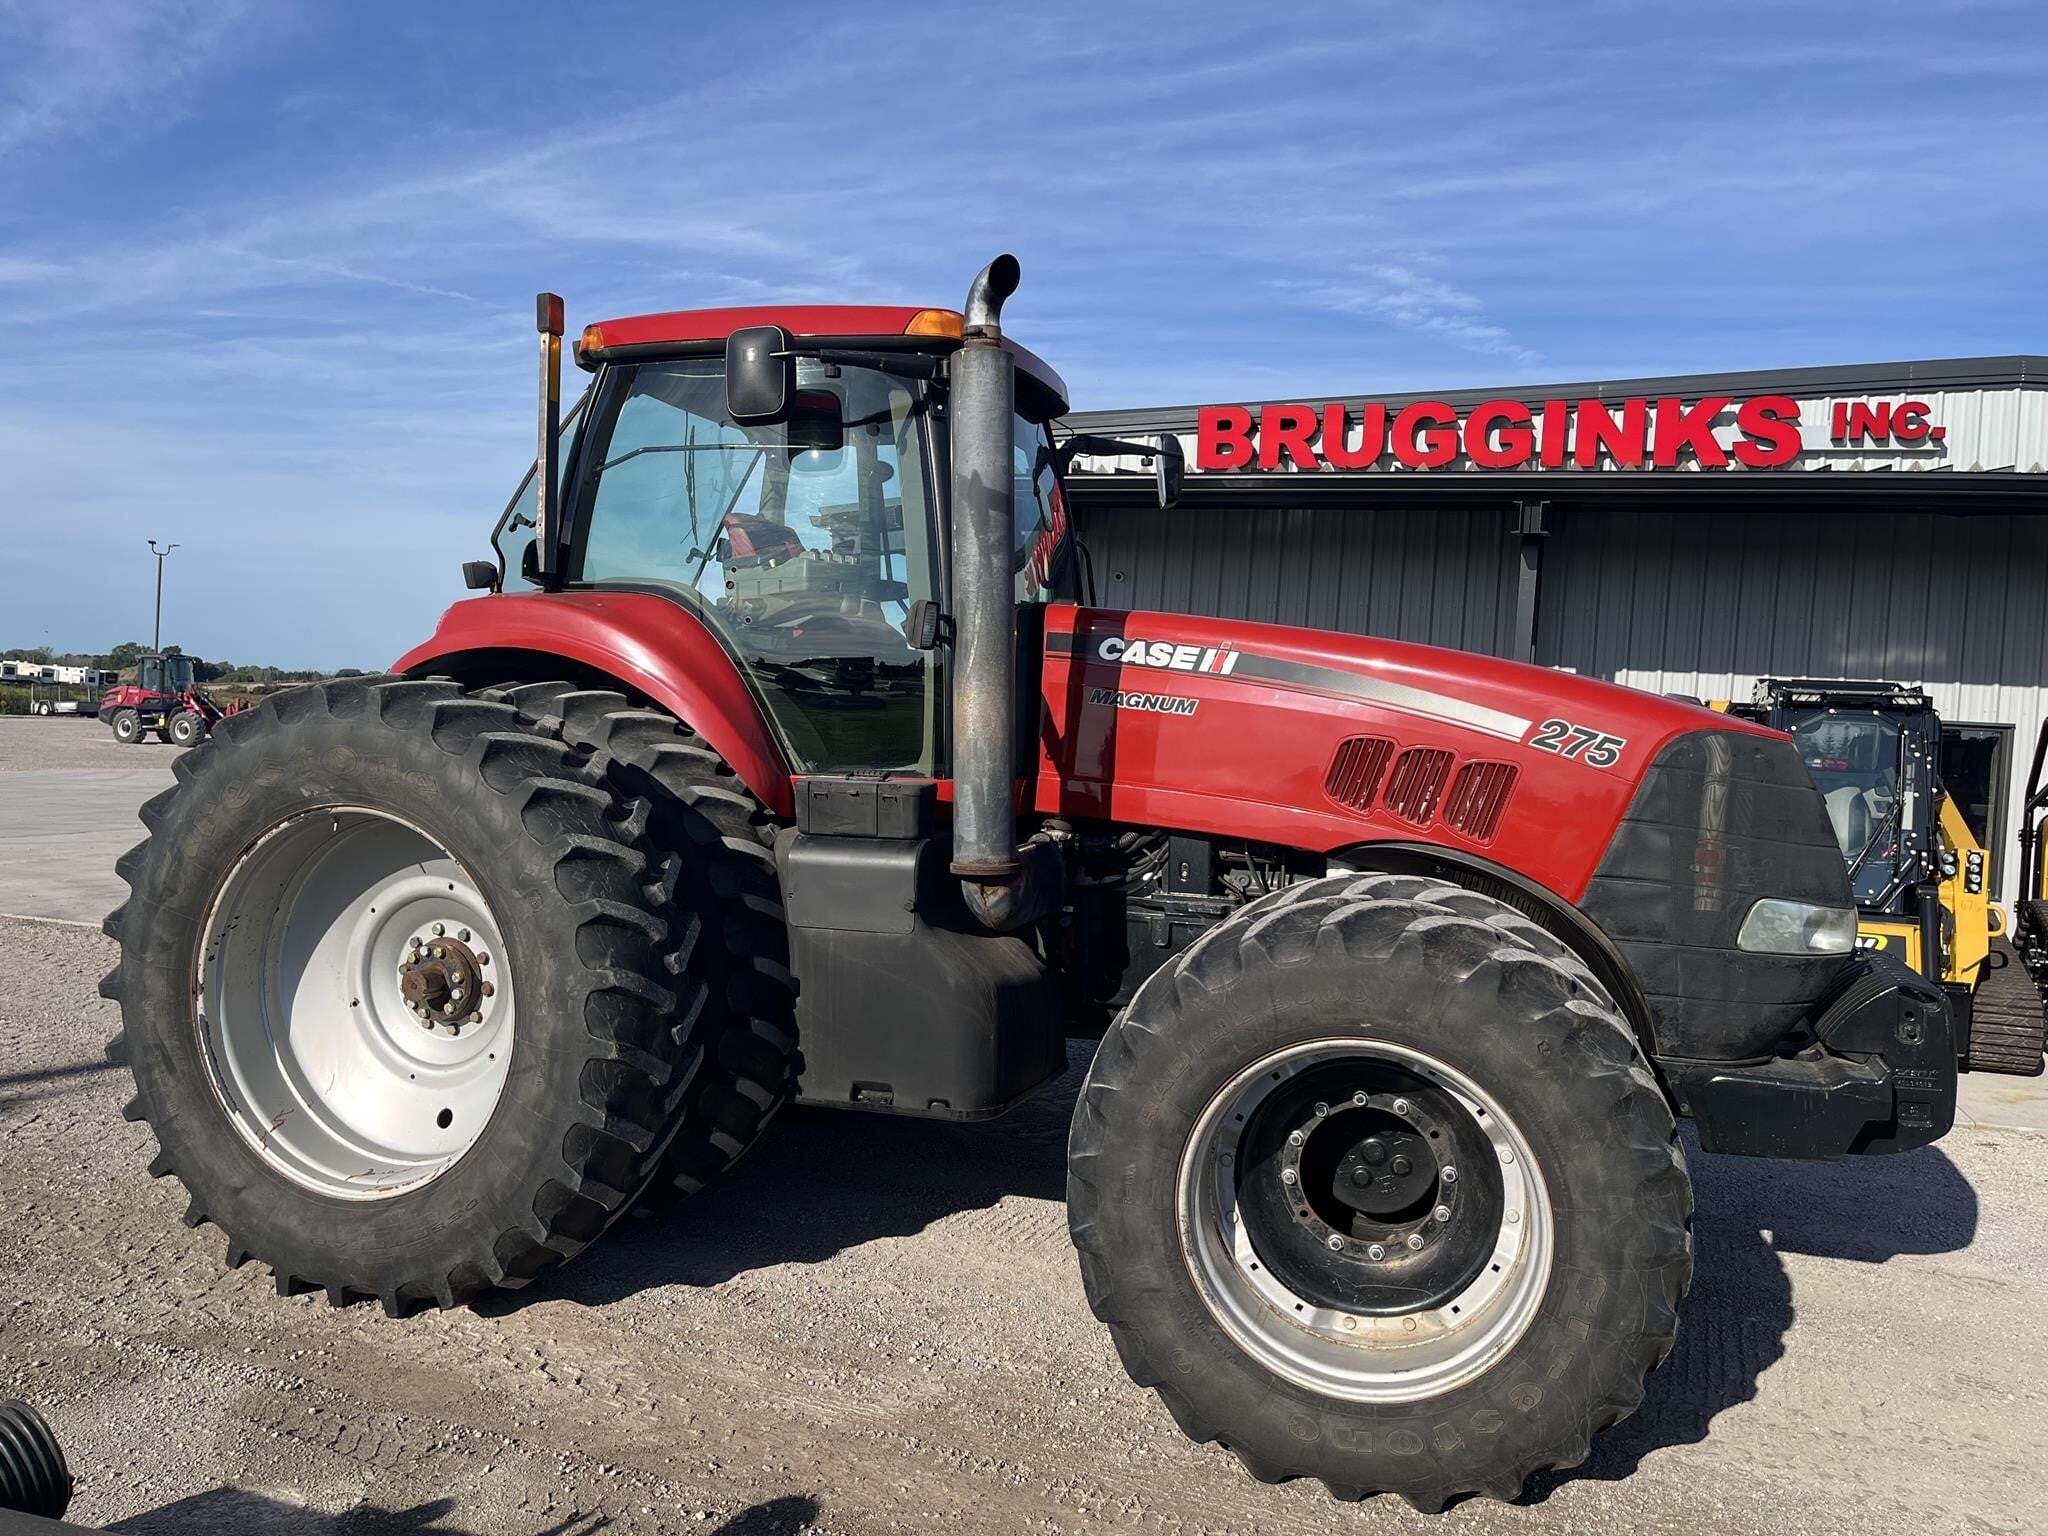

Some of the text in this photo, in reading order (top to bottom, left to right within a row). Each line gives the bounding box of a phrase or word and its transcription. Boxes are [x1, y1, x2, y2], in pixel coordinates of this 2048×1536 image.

[1196, 394, 1946, 470] BRUGGINKS INC.
[1089, 688, 1199, 716] MAGNUM
[1528, 718, 1627, 768] 275
